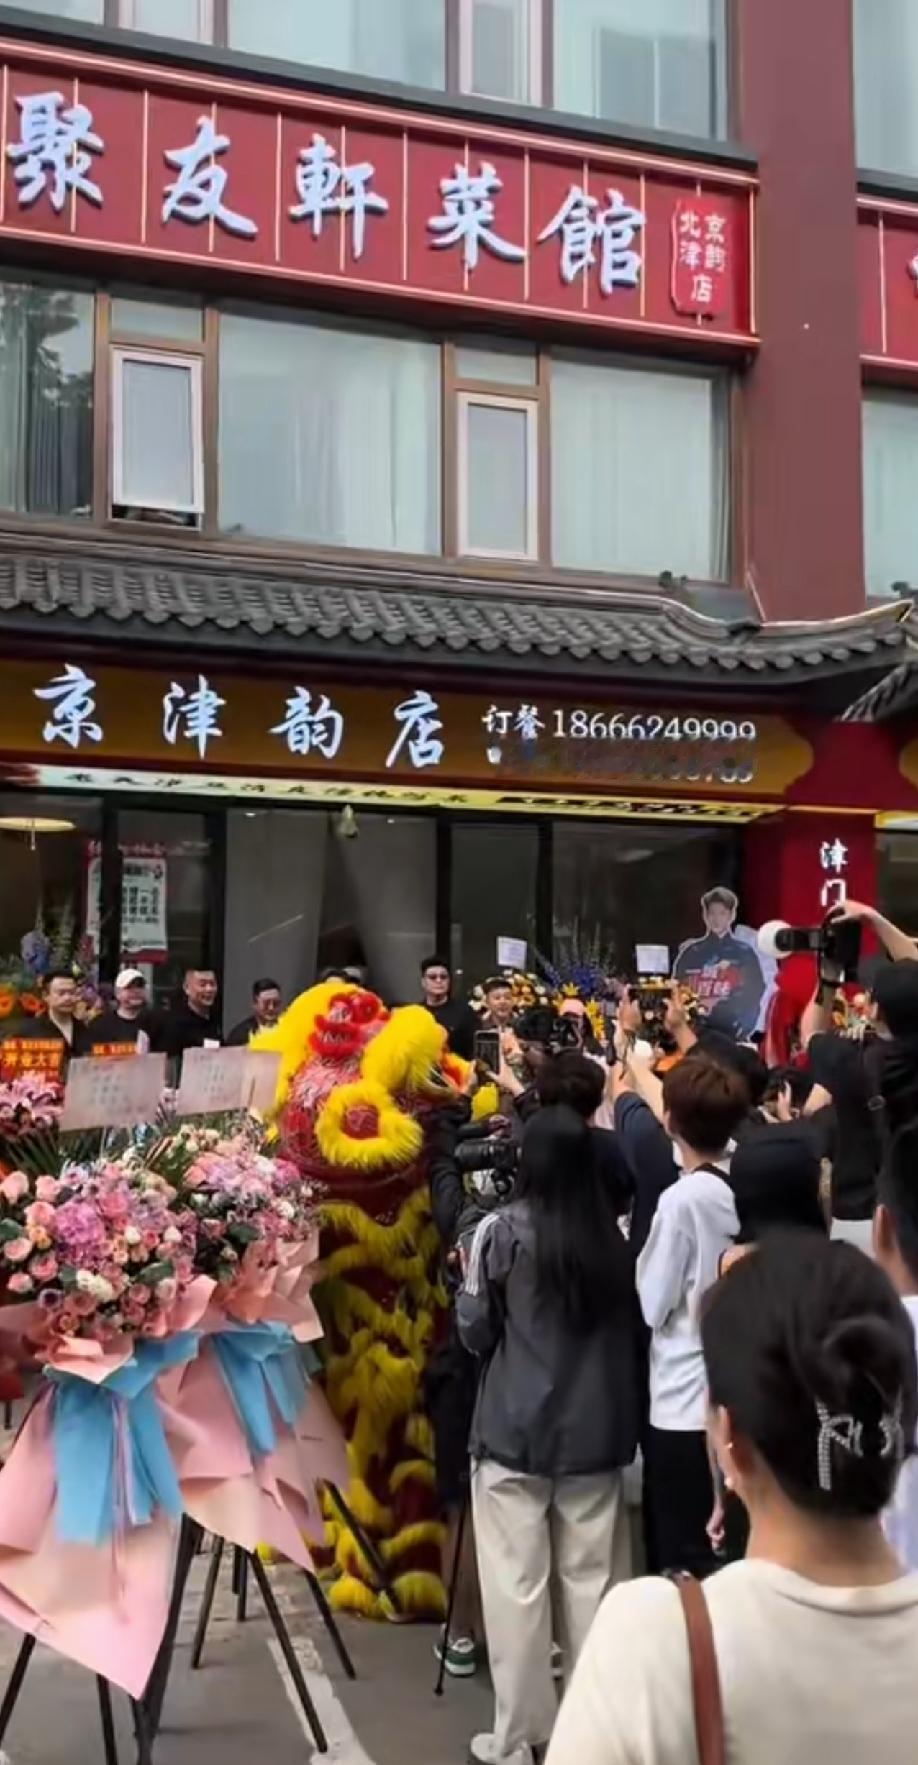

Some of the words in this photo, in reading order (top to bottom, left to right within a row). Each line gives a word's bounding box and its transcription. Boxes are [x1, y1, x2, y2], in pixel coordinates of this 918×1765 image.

[6, 91, 645, 295] 聚友軒菜館
[33, 663, 446, 769] 京津韵店
